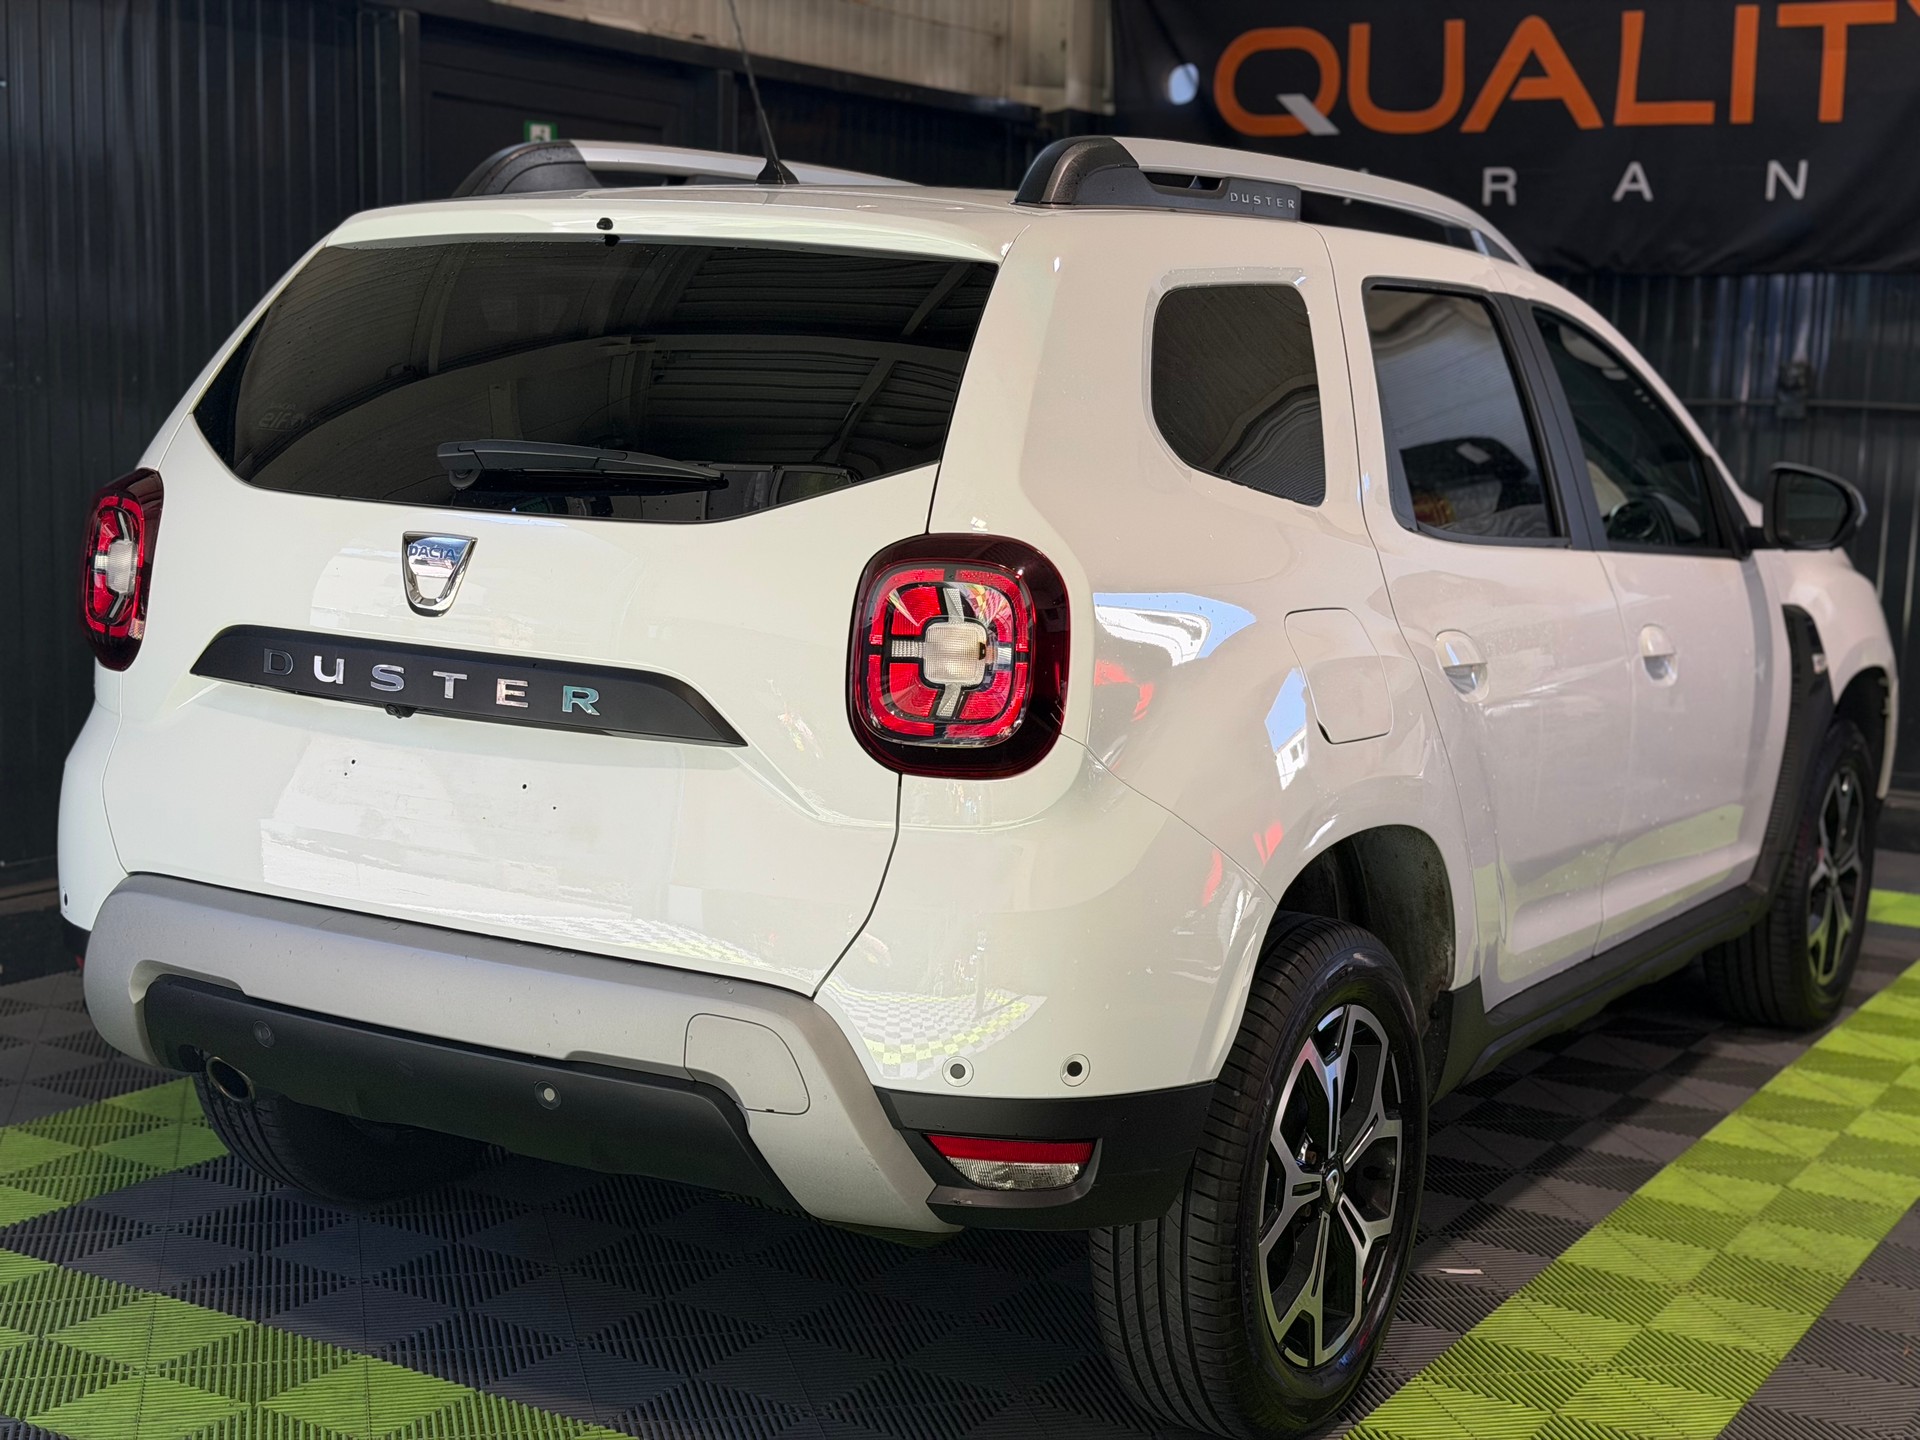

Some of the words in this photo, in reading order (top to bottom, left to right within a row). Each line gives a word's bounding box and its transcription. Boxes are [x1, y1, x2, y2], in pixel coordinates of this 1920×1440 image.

[1214, 0, 1920, 136] QUALIT
[1229, 192, 1297, 209] DUSTER
[407, 544, 456, 561] DACIA
[263, 648, 601, 716] DUSTER
